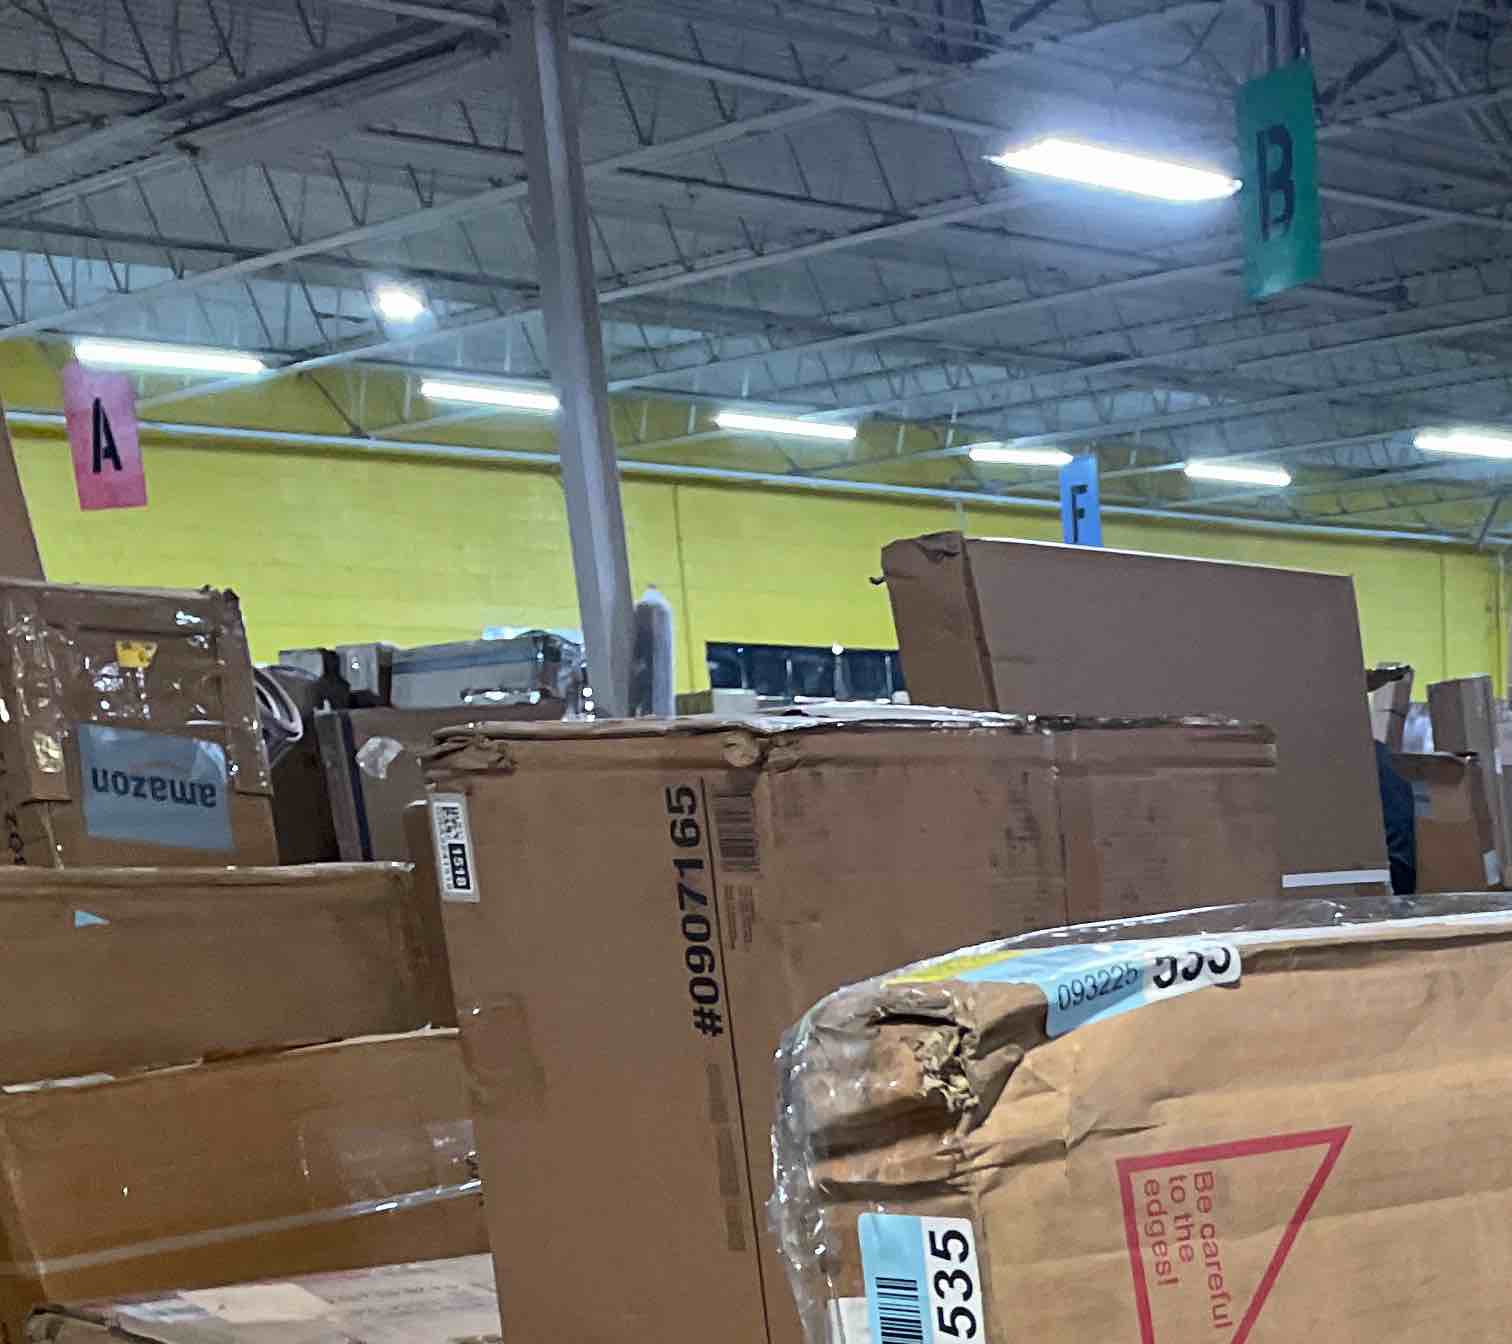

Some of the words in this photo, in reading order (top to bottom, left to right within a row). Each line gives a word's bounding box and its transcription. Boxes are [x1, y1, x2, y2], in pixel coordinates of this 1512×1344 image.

[1254, 123, 1294, 244] B
[91, 397, 123, 475] A
[91, 768, 217, 811] amazon
[664, 785, 726, 1037] #0907165
[1056, 961, 1141, 1013] 093225
[1168, 1174, 1188, 1204] to
[1193, 1171, 1216, 1214] Be
[1143, 1178, 1180, 1287] edges!
[1174, 1212, 1196, 1263] the
[928, 1228, 978, 1340] 535
[1200, 1222, 1234, 1330] careful
